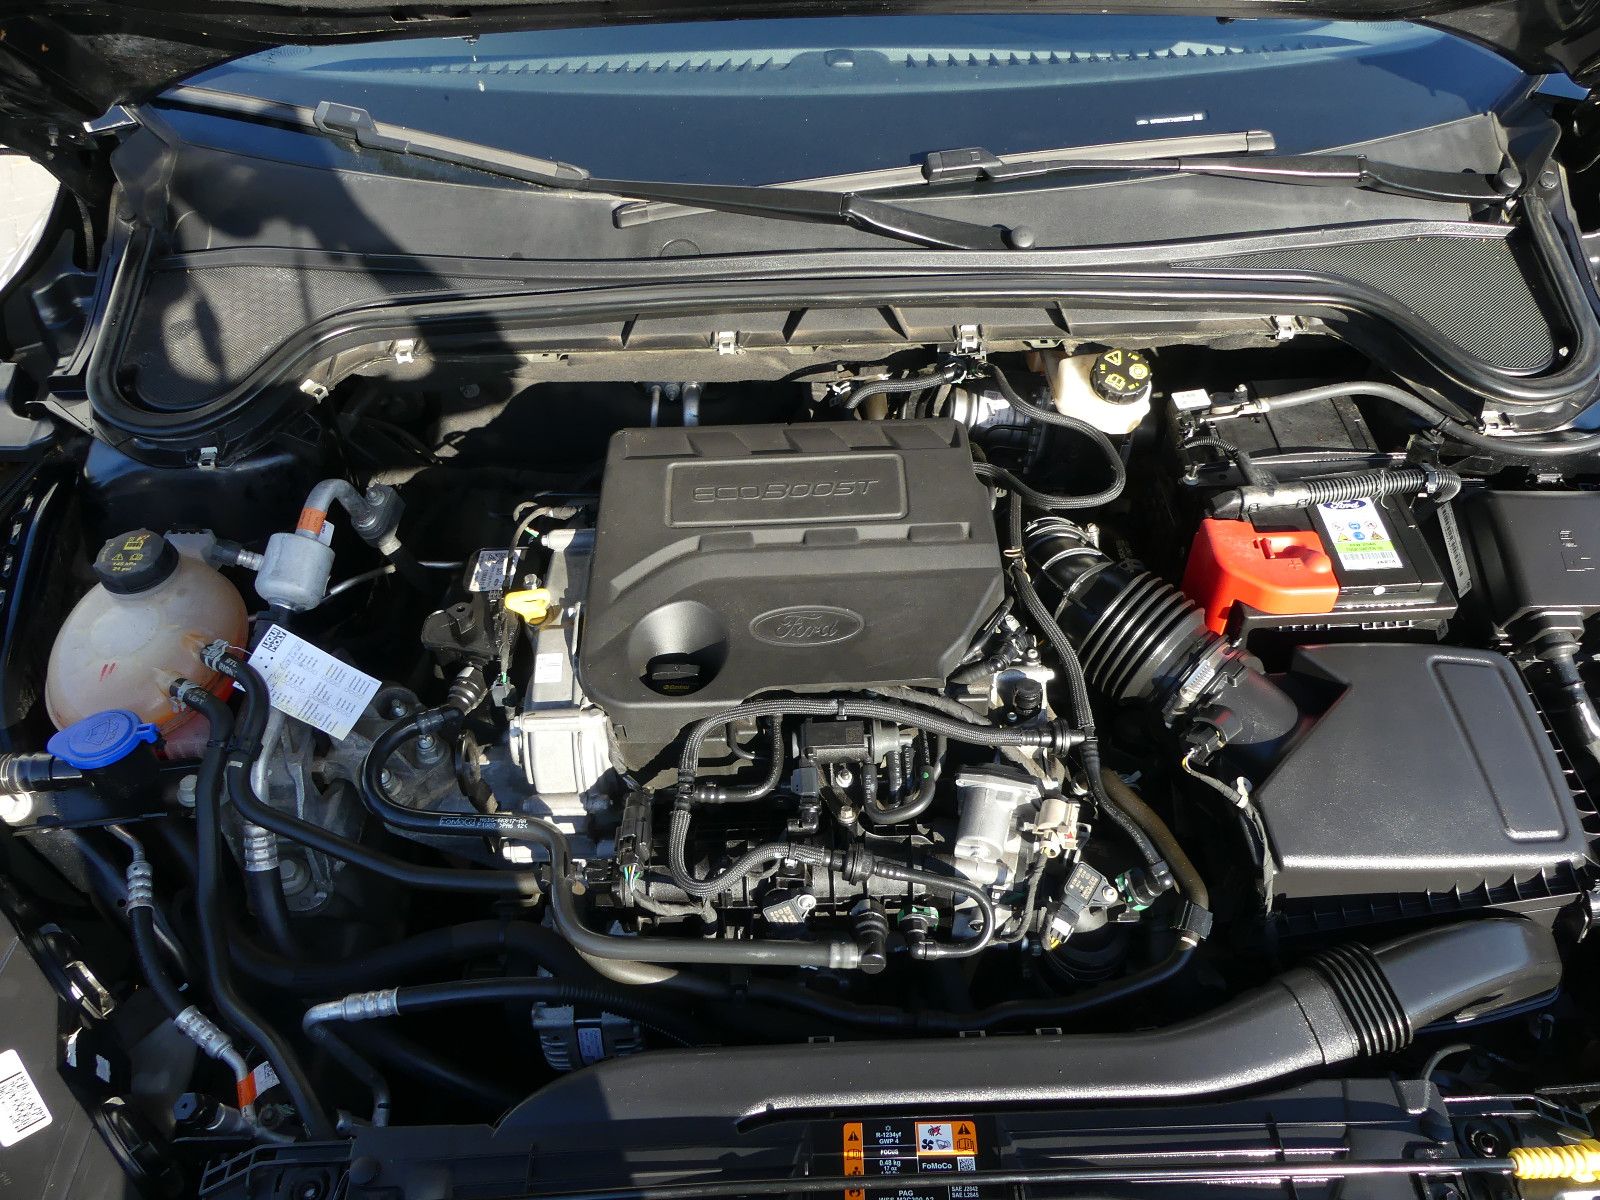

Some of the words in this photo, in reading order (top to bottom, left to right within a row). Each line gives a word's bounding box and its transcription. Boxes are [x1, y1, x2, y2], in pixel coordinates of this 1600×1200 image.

[693, 480, 879, 503] ECOBOOST
[775, 614, 839, 638] Ford
[262, 627, 281, 649] LIQUI
[269, 631, 287, 652] MOLY
[893, 1159, 901, 1167] kg
